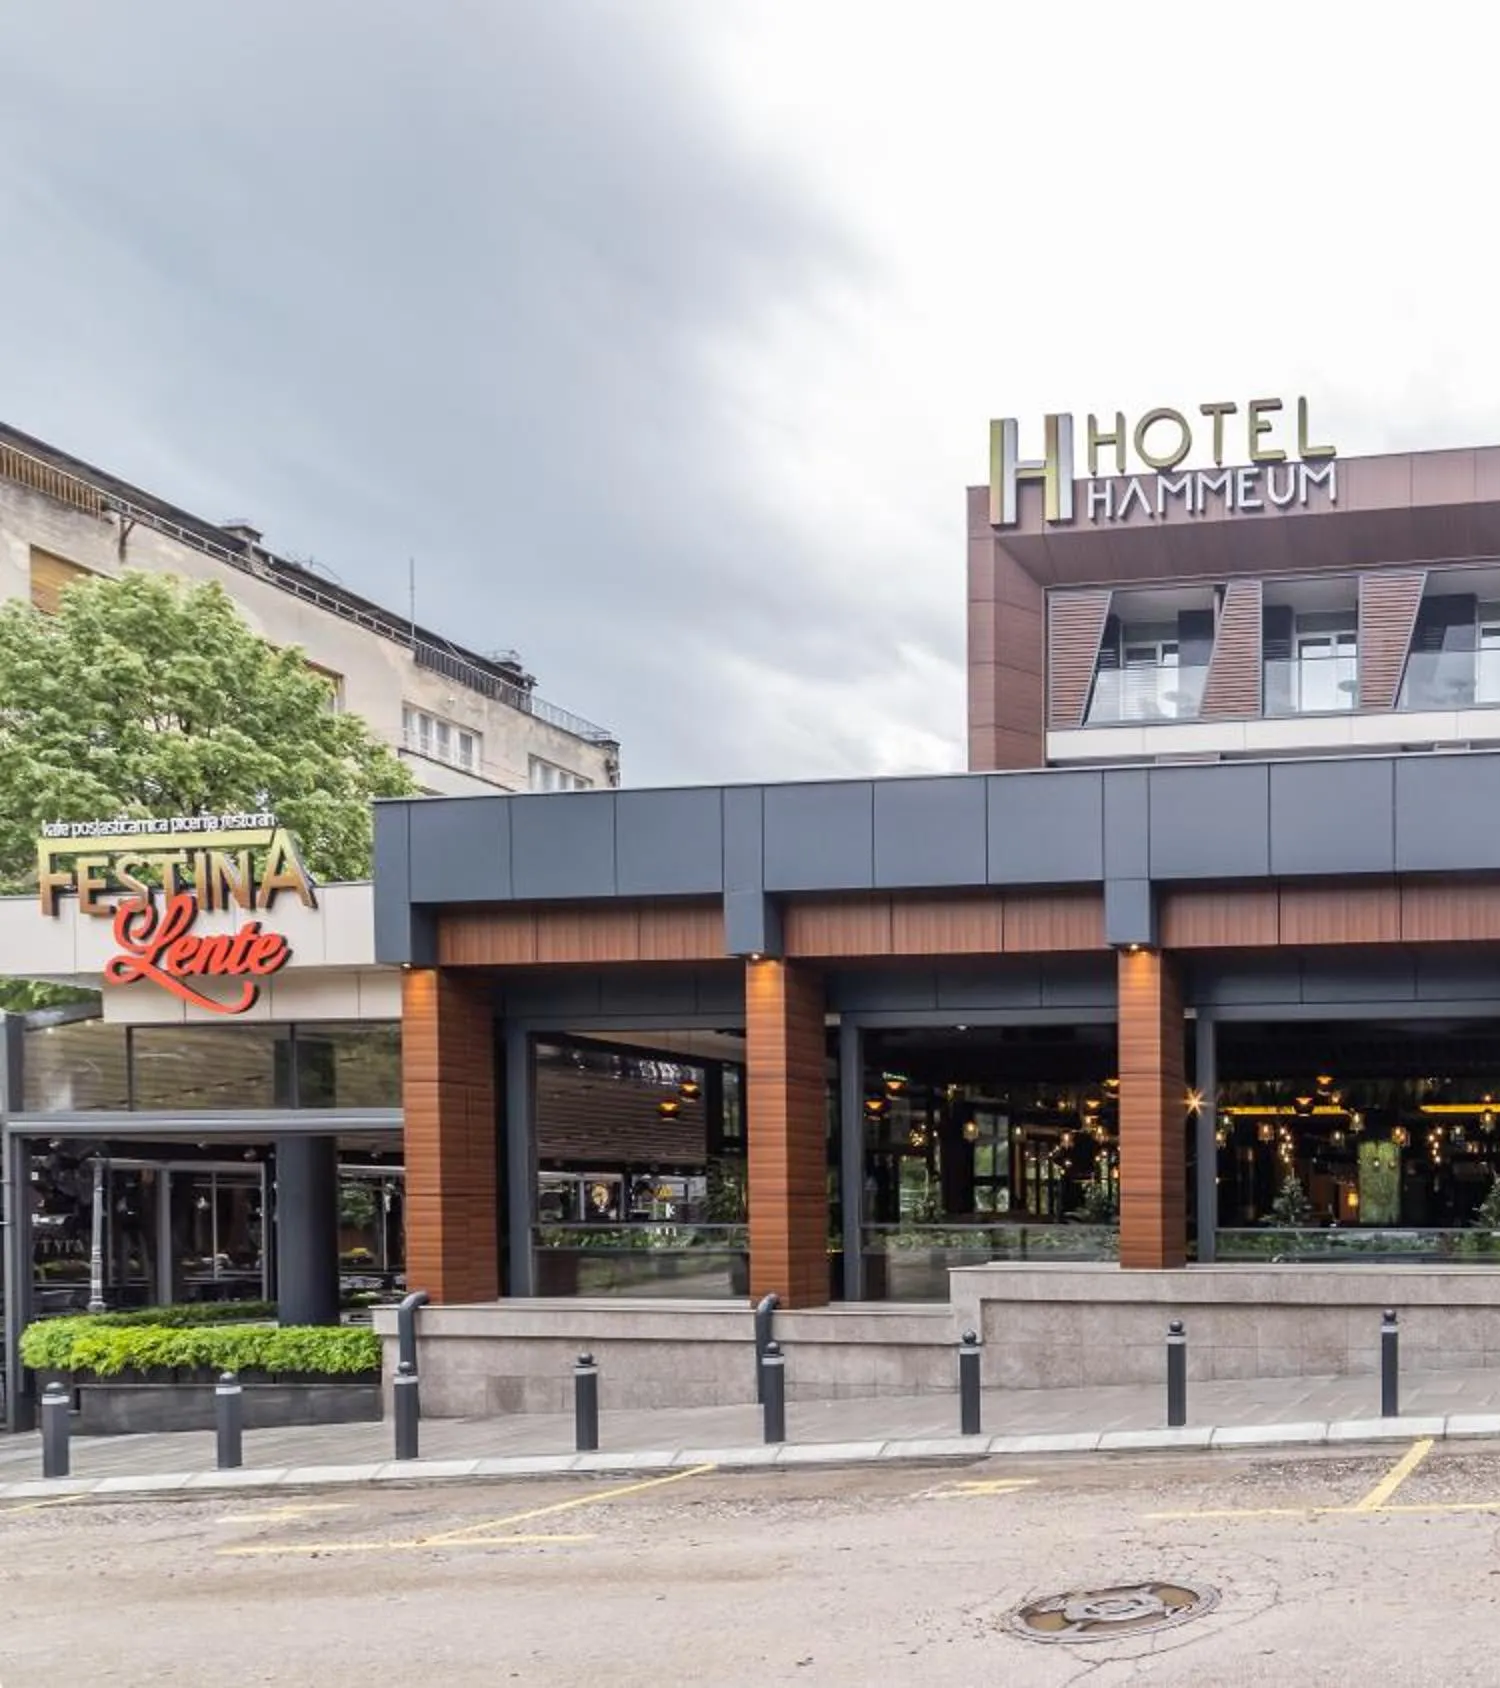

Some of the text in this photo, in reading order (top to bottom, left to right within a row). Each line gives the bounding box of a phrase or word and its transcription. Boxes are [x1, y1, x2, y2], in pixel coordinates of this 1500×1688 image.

[989, 413, 1074, 526] H
[1087, 396, 1337, 477] HOTEL
[1087, 460, 1338, 524] HAMMEUM
[37, 828, 318, 918] FESTINA
[105, 892, 292, 1014] Lente
